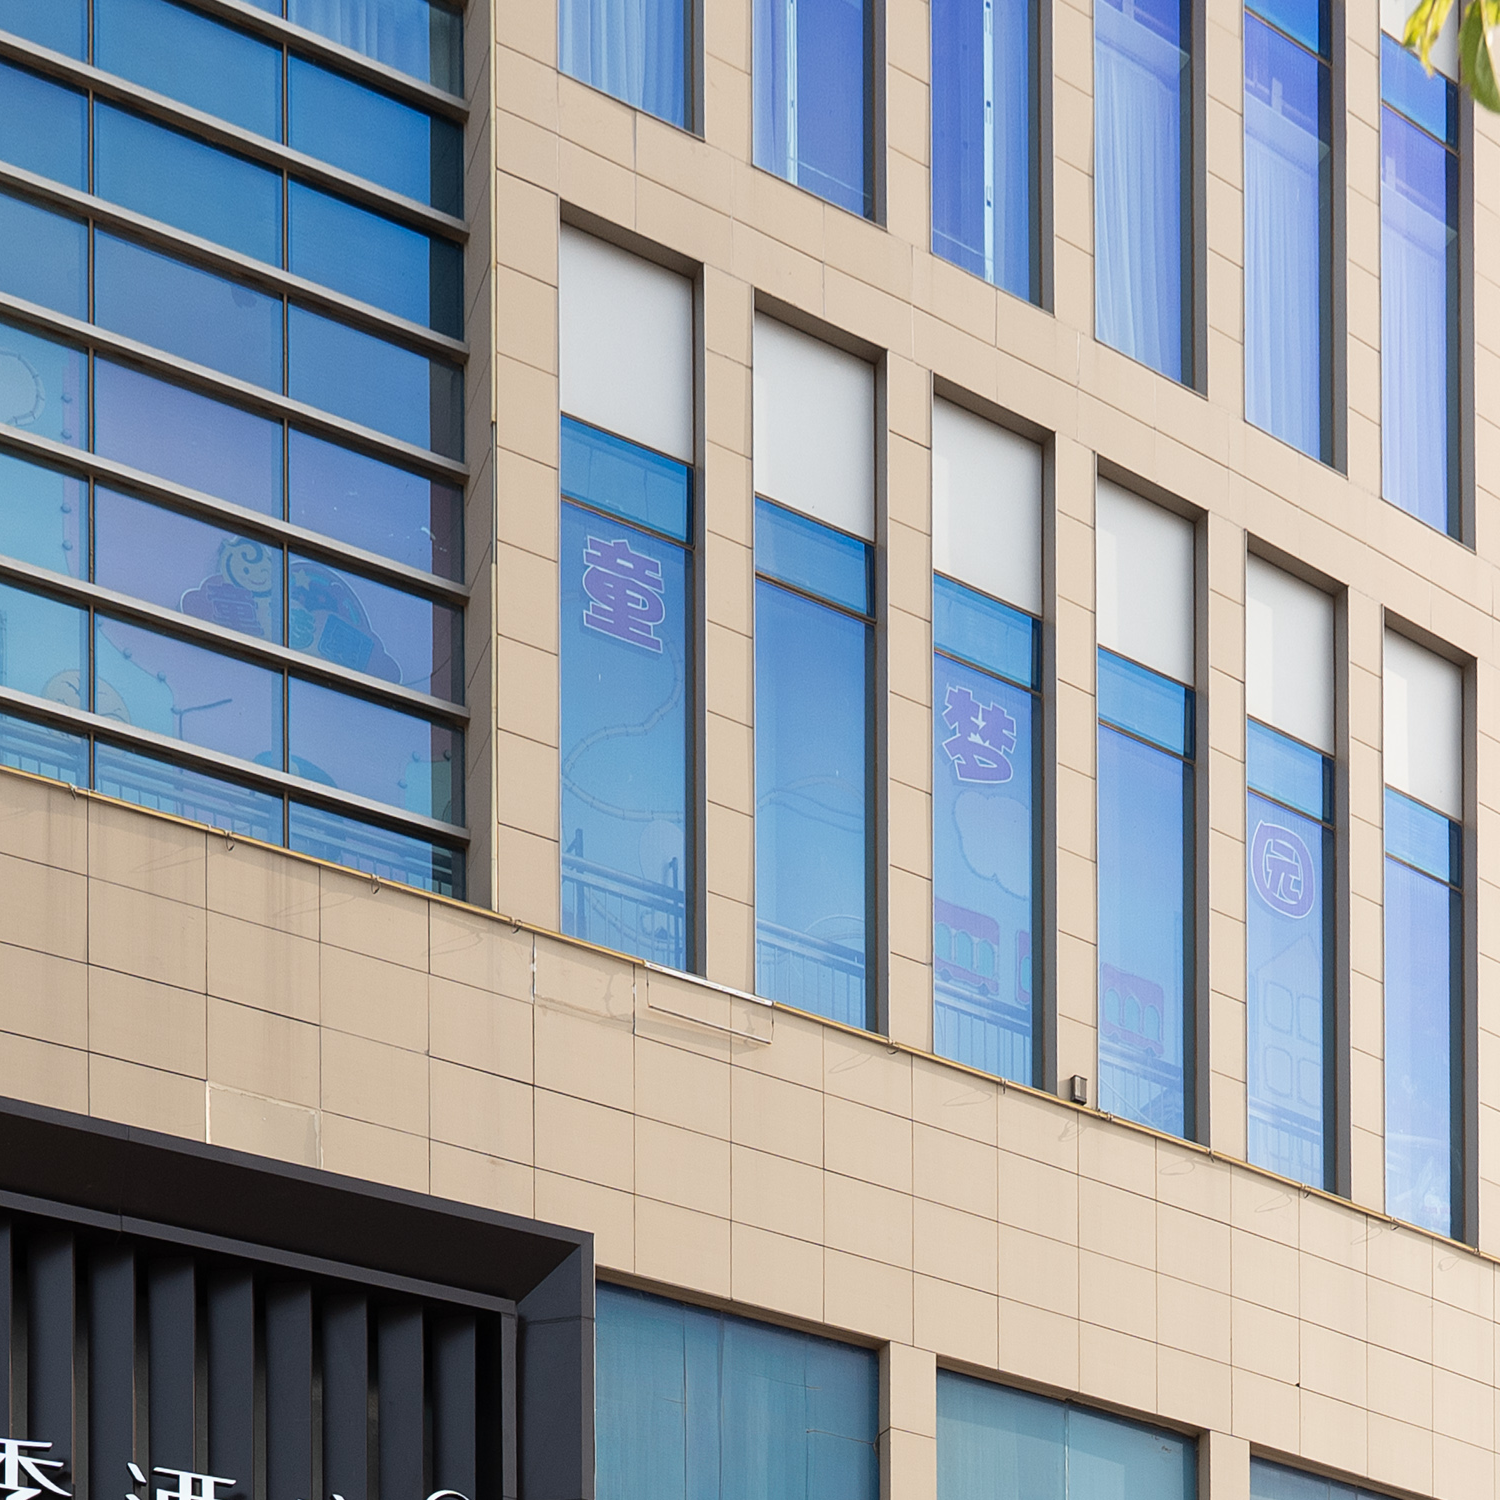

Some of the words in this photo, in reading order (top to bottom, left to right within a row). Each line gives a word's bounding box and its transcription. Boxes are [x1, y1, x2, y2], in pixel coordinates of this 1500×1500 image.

[581, 535, 666, 654] 童
[943, 685, 1018, 786] 梦
[1250, 819, 1315, 920] 园
